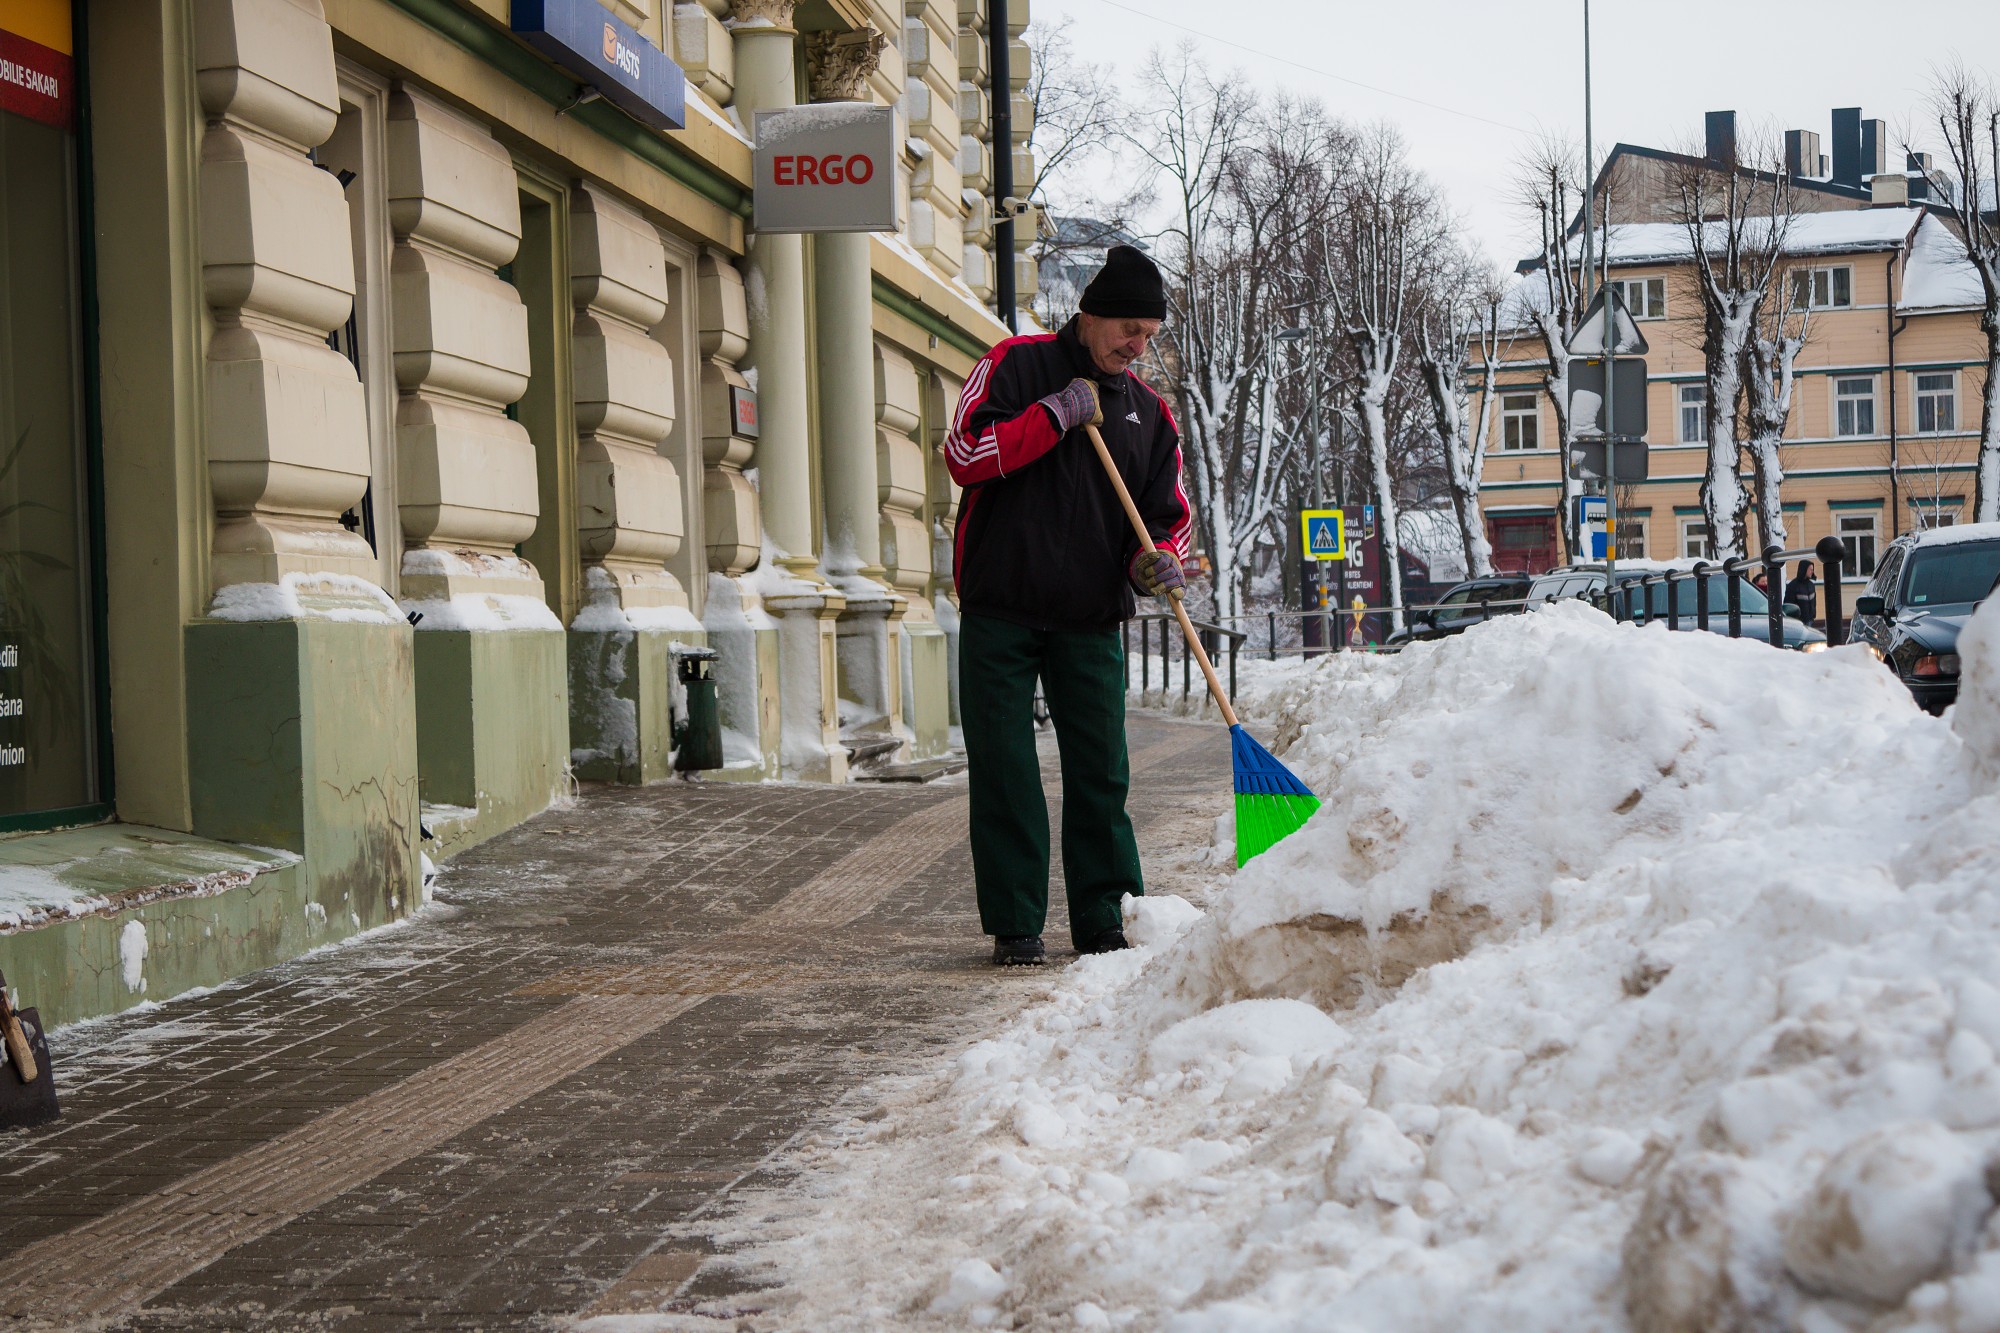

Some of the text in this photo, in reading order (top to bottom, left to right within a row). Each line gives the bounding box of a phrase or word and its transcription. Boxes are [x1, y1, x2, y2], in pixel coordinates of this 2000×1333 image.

[616, 42, 640, 80] PASTS
[25, 68, 58, 99] SAKARI
[773, 154, 874, 186] ERGO
[0, 645, 18, 667] dīti
